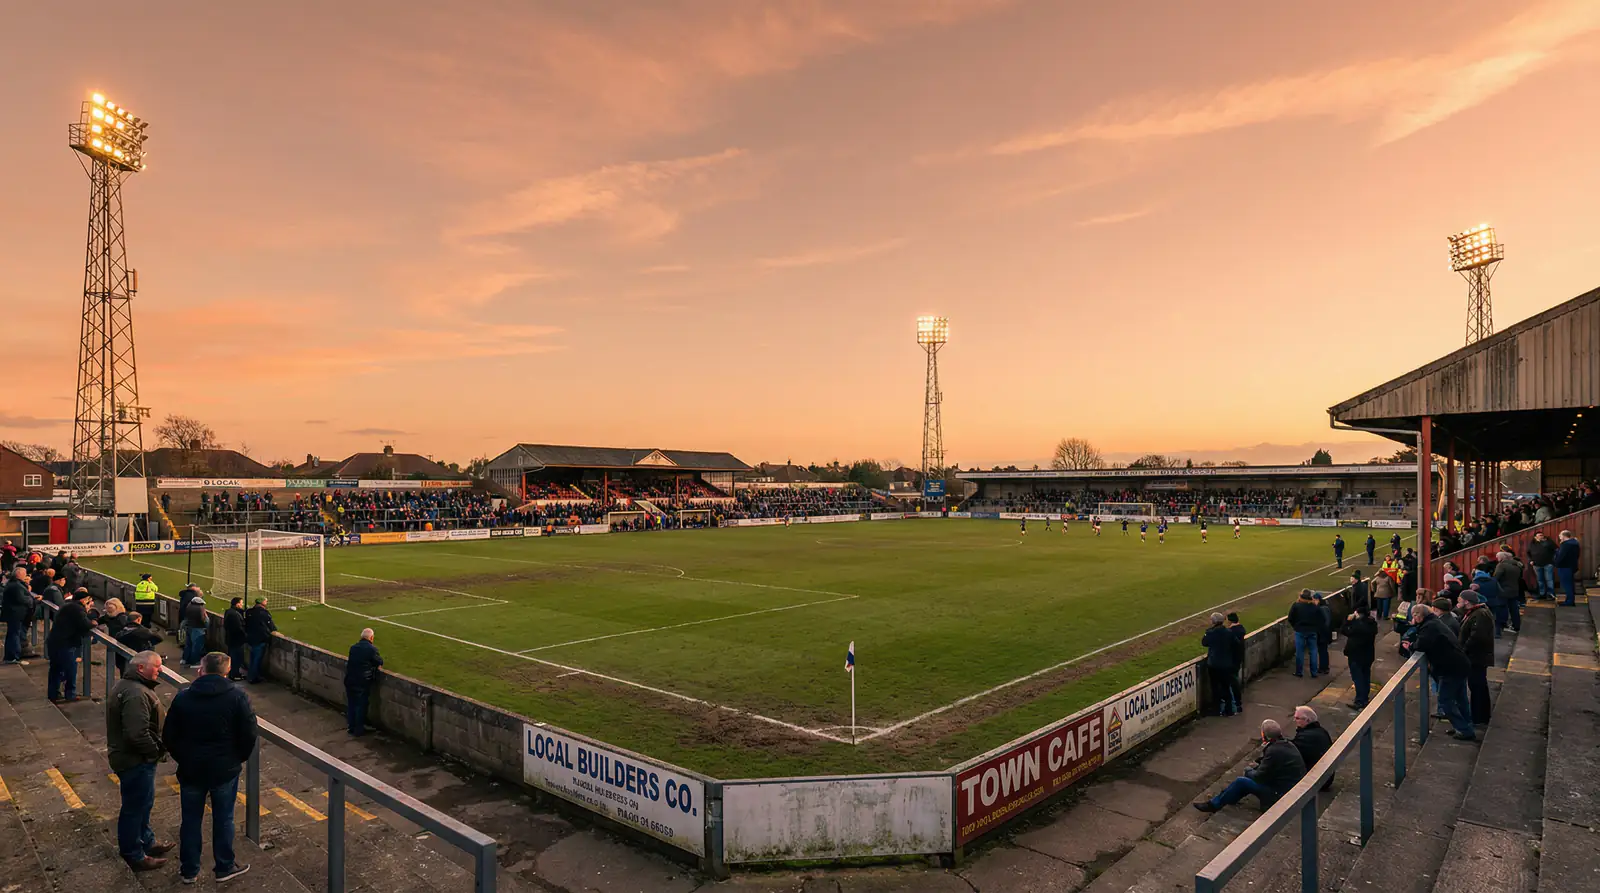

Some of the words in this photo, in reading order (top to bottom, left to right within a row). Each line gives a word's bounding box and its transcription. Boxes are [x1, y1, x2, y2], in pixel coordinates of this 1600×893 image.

[1124, 691, 1149, 721] LOCAL
[1150, 675, 1183, 708] BUILDERS
[1184, 670, 1195, 690] CO.
[527, 729, 574, 770] LOCAL
[577, 747, 660, 802] BUILDERS
[665, 778, 698, 817] CO.
[961, 745, 1041, 816] TOWN
[1048, 717, 1101, 772] CAFE
